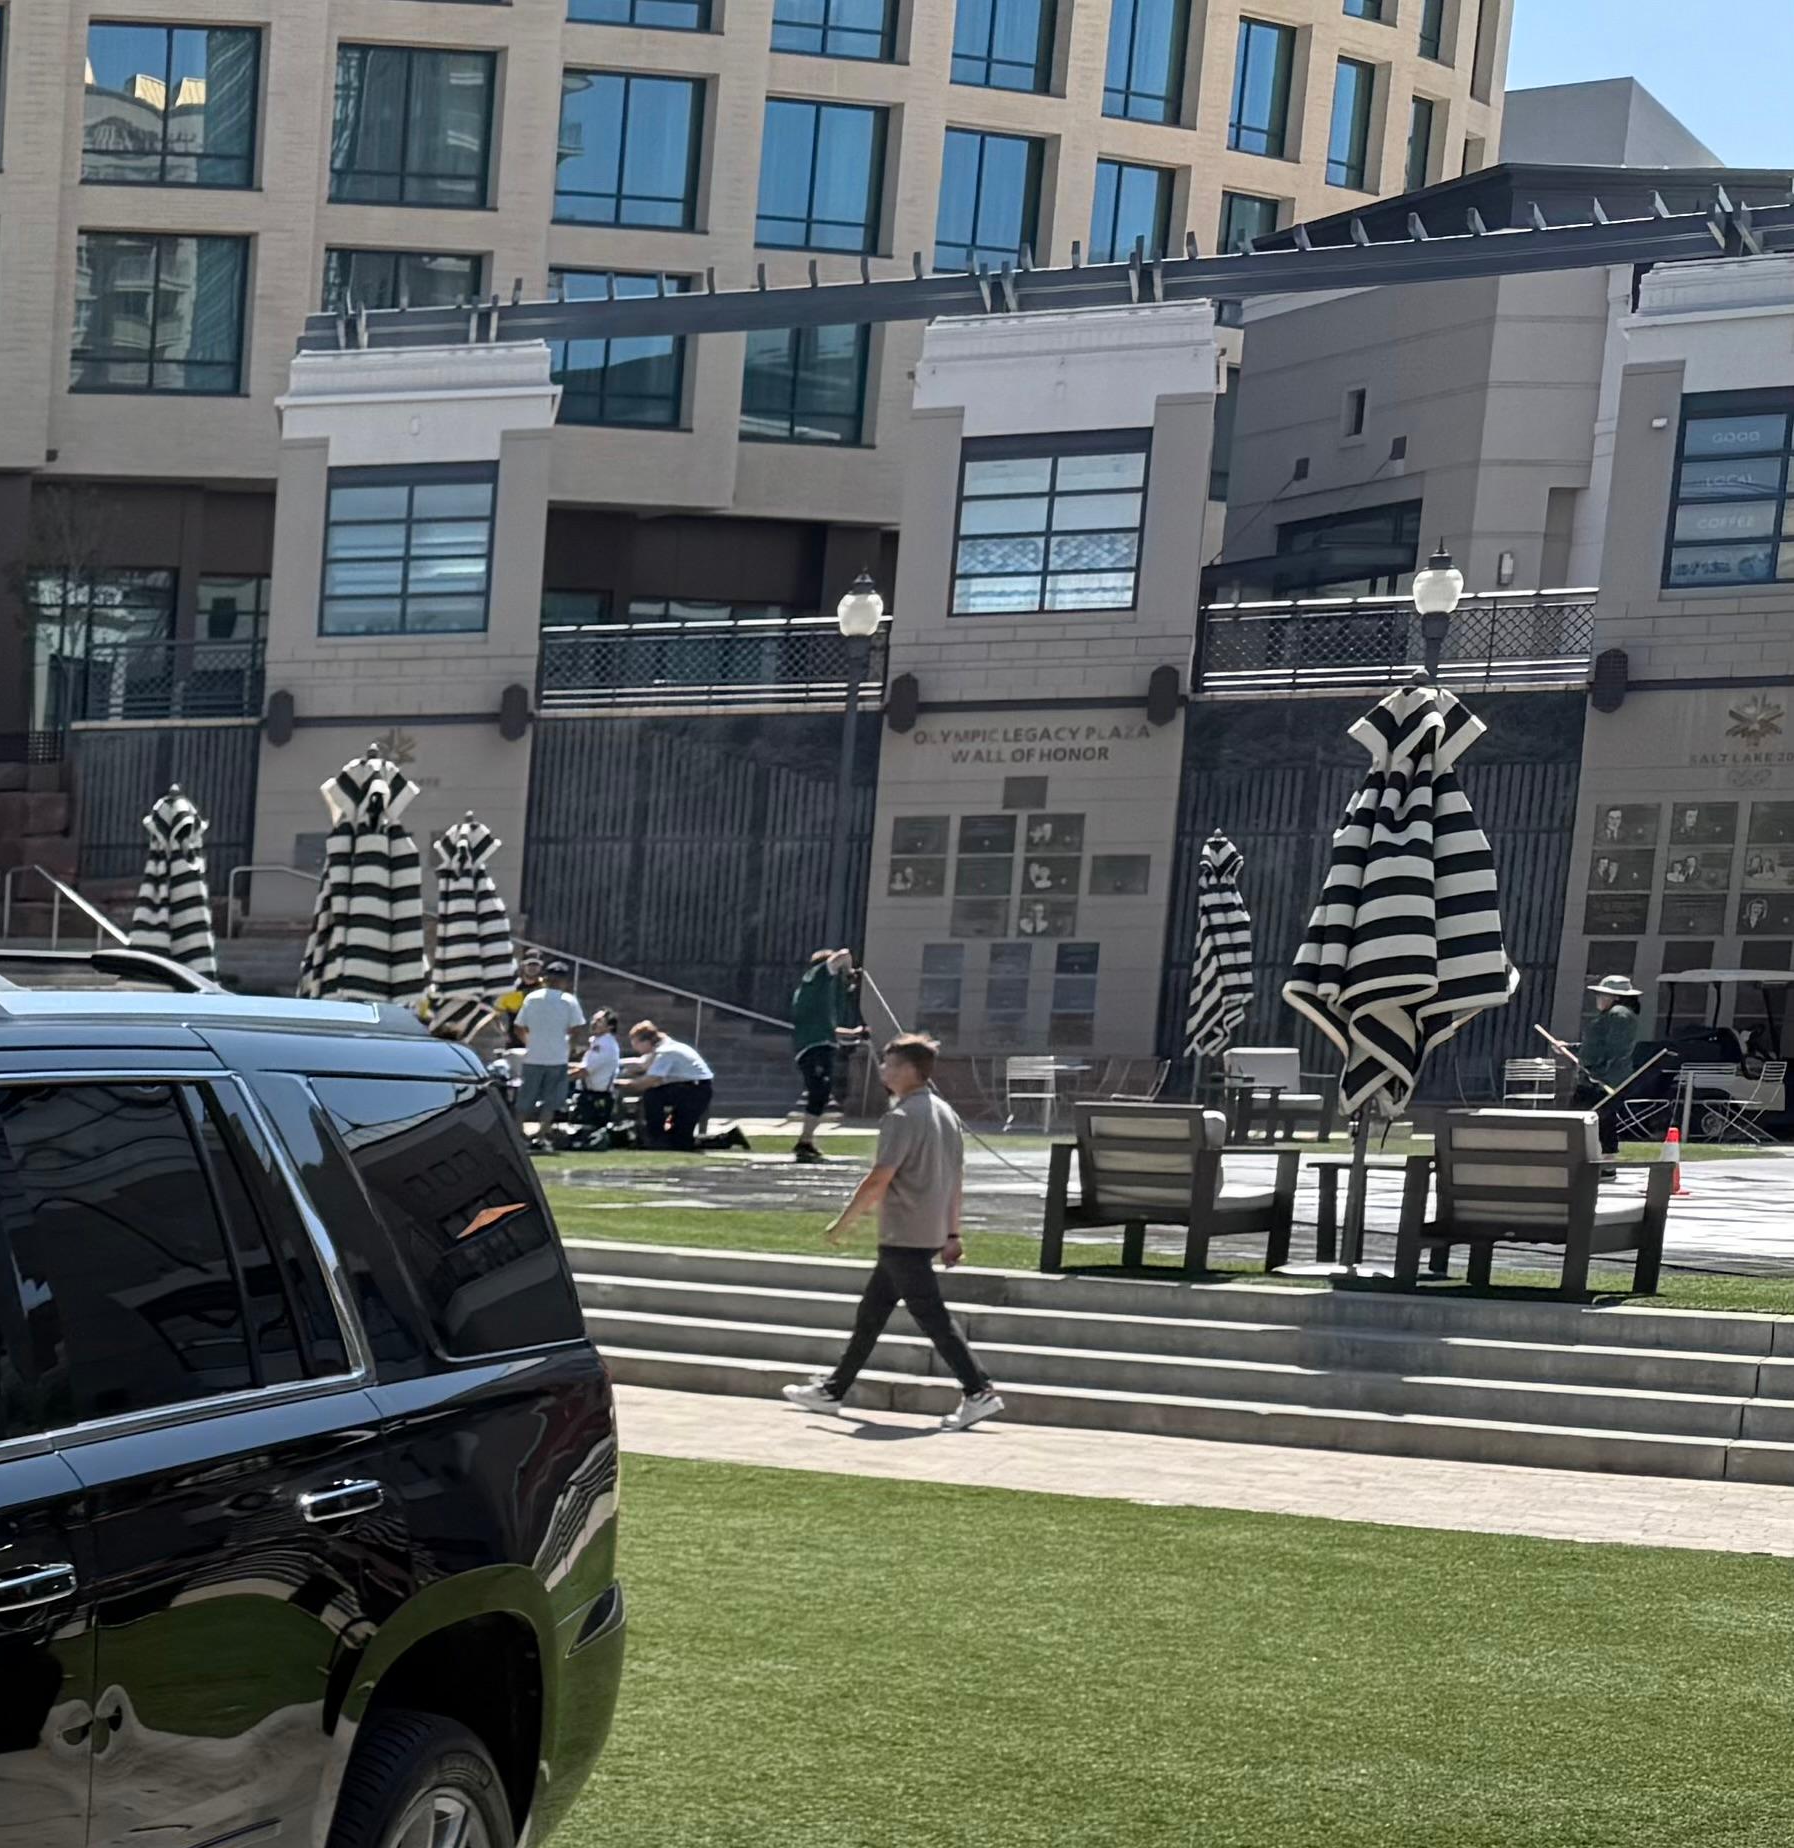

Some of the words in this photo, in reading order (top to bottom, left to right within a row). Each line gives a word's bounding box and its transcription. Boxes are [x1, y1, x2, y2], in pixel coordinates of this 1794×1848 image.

[1712, 430, 1760, 444] GOOD
[913, 727, 1000, 745] OLYMPIC
[1003, 726, 1081, 743] LEGACY
[1085, 724, 1151, 741] PLAZA
[951, 748, 1006, 763] WALL
[1011, 747, 1036, 763] OF
[1039, 746, 1110, 762] HONOR
